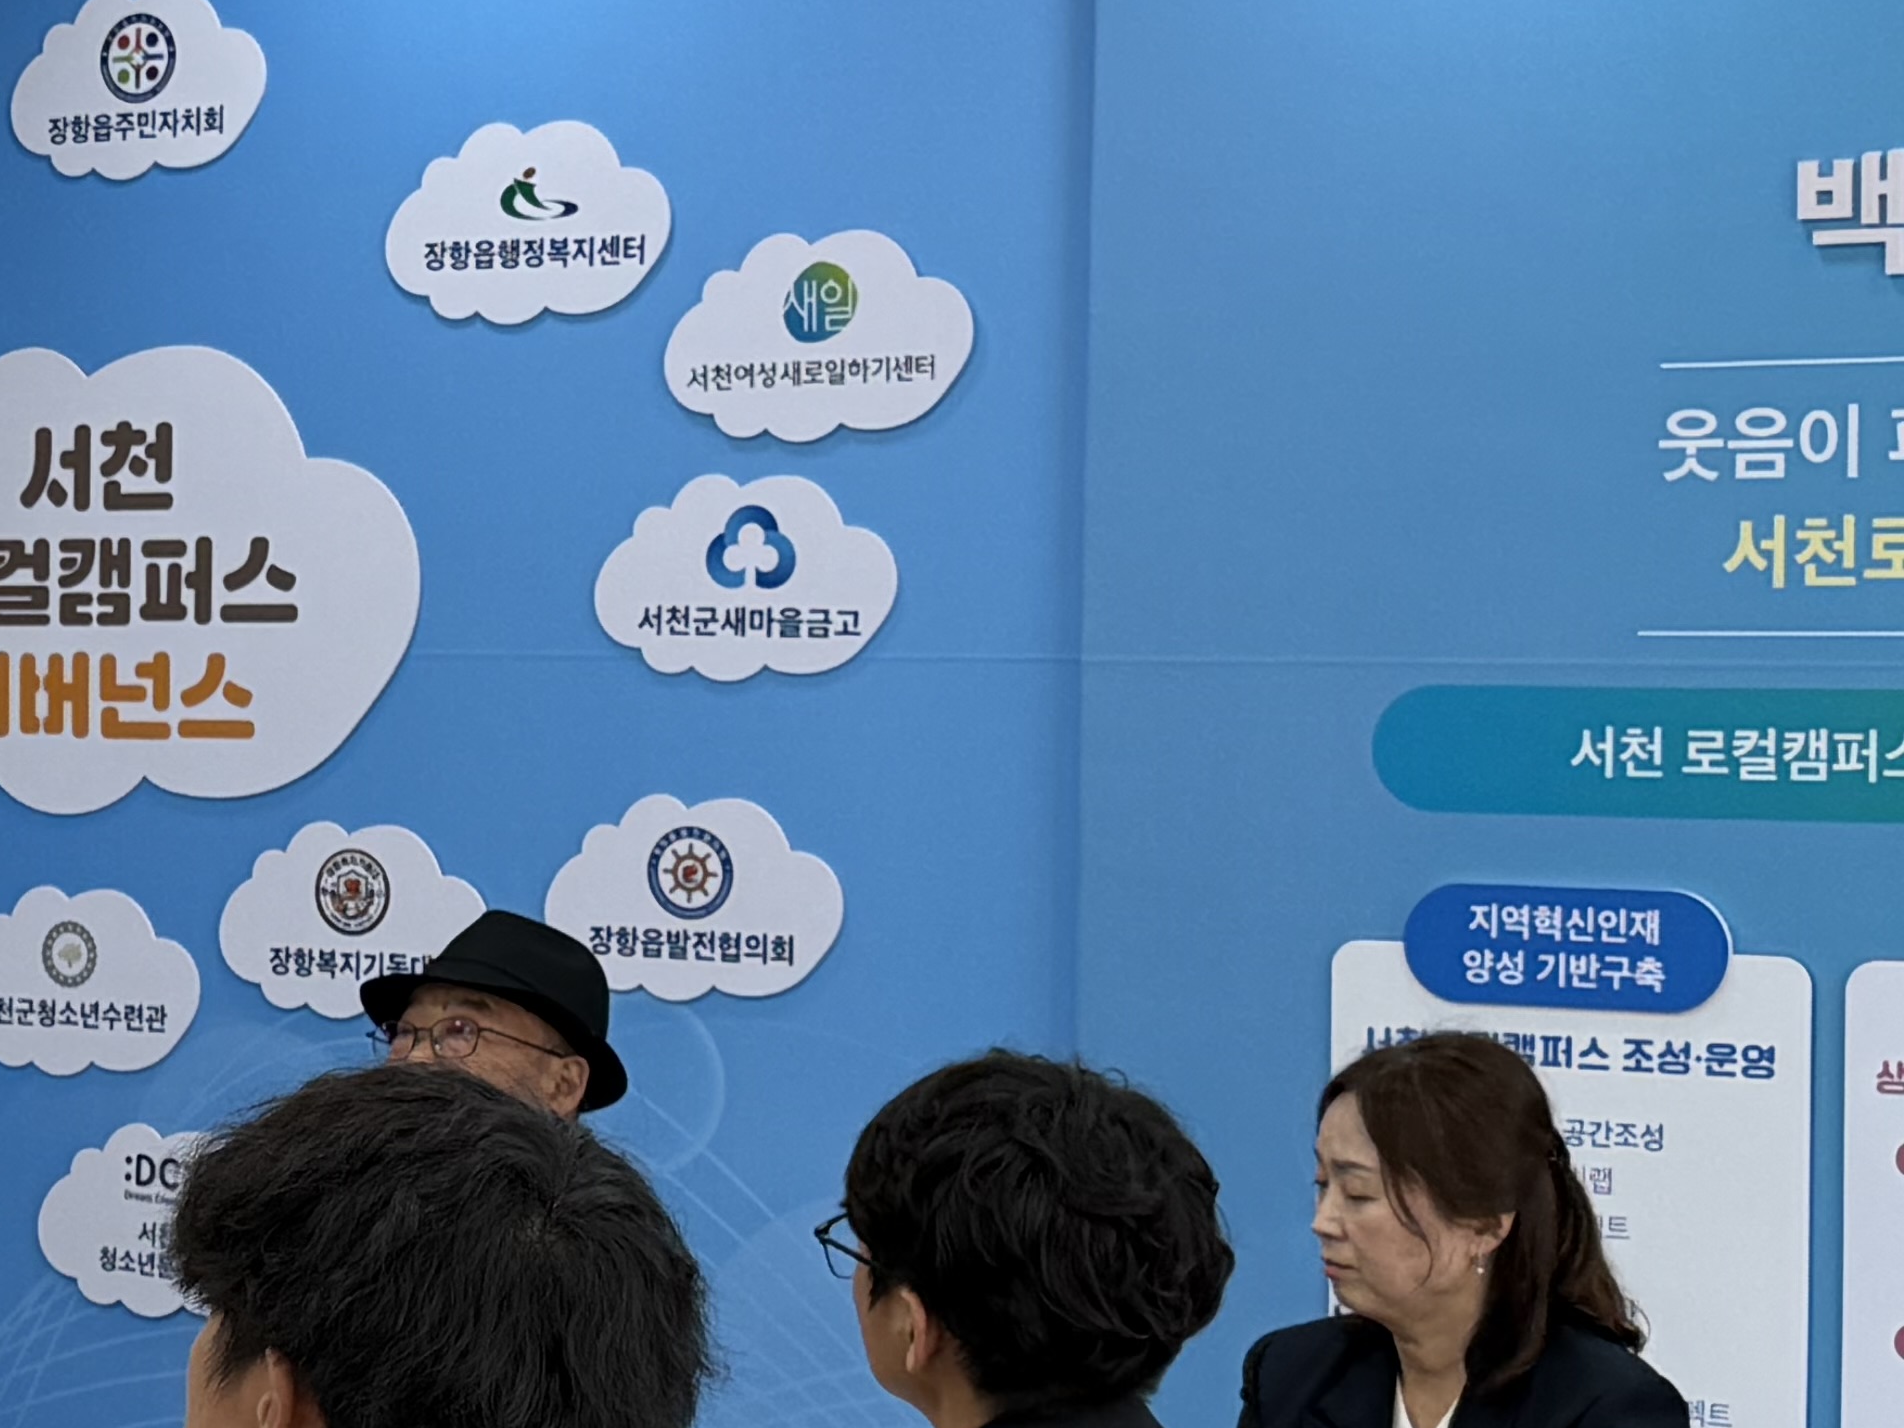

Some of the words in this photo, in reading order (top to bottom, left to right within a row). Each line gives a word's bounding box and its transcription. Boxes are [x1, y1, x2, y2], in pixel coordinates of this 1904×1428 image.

[47, 104, 225, 146] 장항읍주민자치회
[423, 234, 647, 272] 장항읍행정복지센터
[686, 353, 936, 393] 서천여성새로일하기센터
[1658, 403, 1859, 482] 웃음이
[19, 420, 174, 512] 서천
[637, 604, 862, 639] 서천군새마을금고
[1570, 725, 1664, 779] 서천
[1468, 902, 1660, 946] 지역혁신인재
[587, 925, 794, 969] 장항읍발전협의회
[1462, 948, 1525, 986] 양성
[1536, 951, 1666, 993] 기반구축
[1621, 1038, 1776, 1080] 조성·운영
[1562, 1118, 1666, 1154] 공간조성
